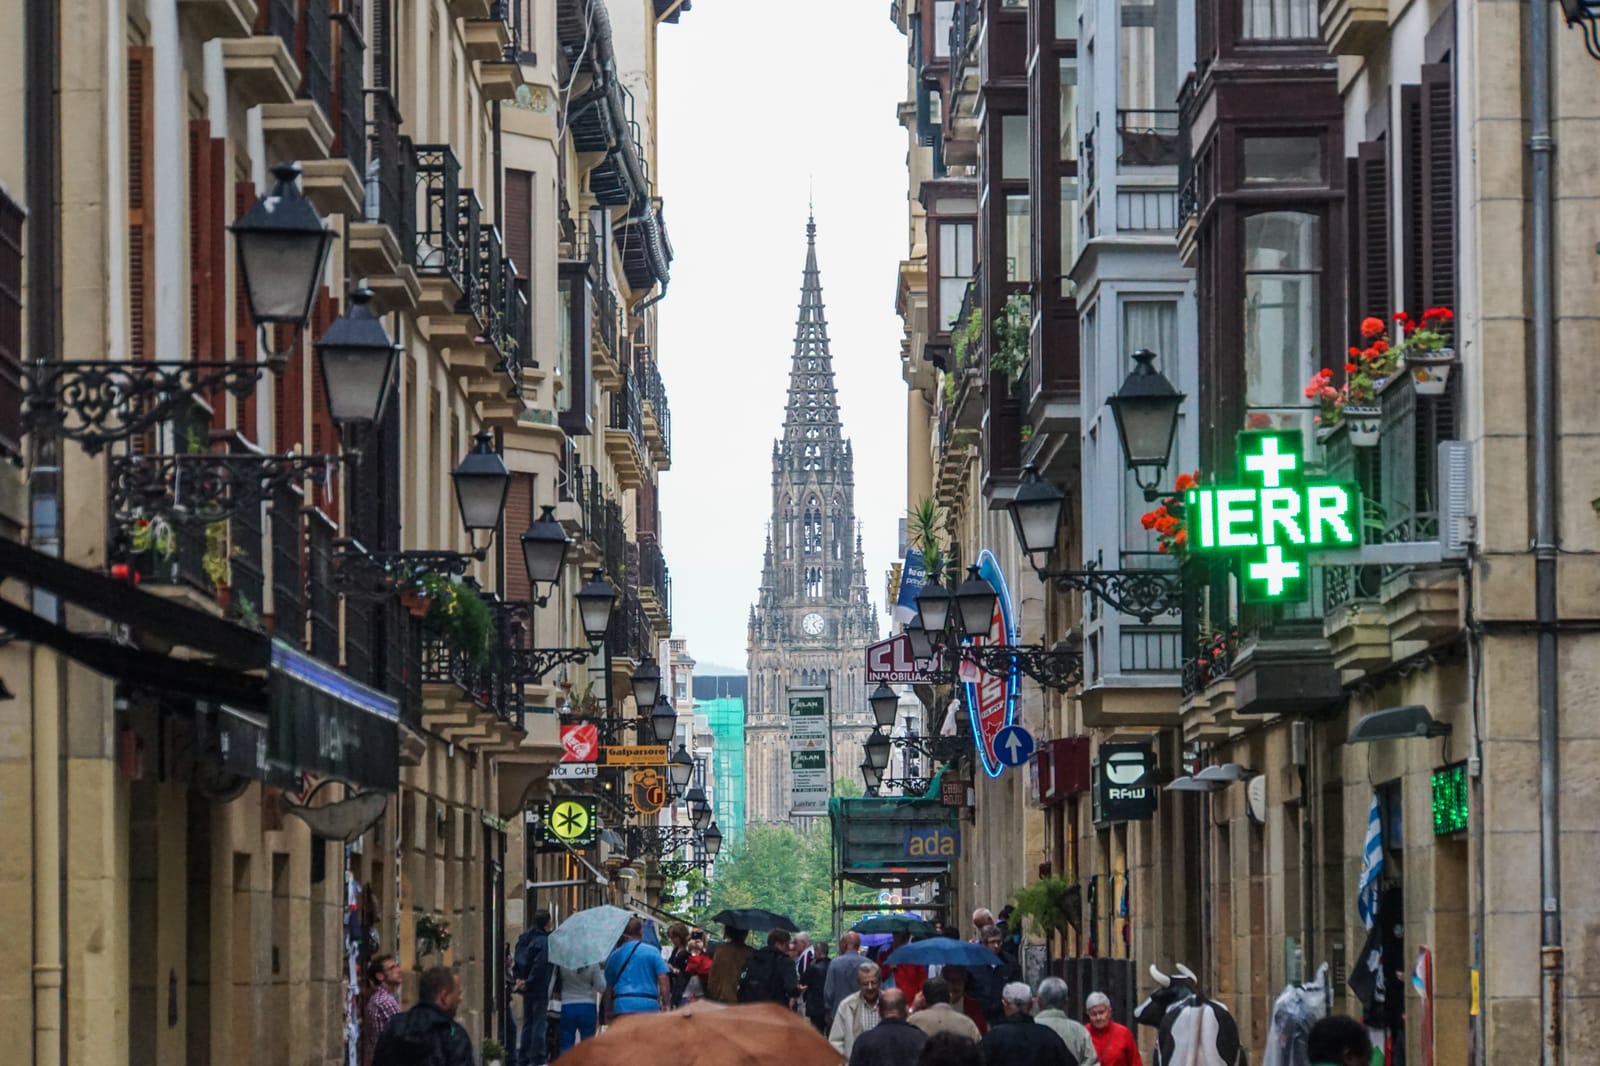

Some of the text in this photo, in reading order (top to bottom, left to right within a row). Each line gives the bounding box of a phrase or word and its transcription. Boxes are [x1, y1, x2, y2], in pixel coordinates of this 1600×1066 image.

[1189, 486, 1354, 547] IERR
[869, 672, 937, 681] INMOBILIAR
[909, 830, 954, 856] ada
